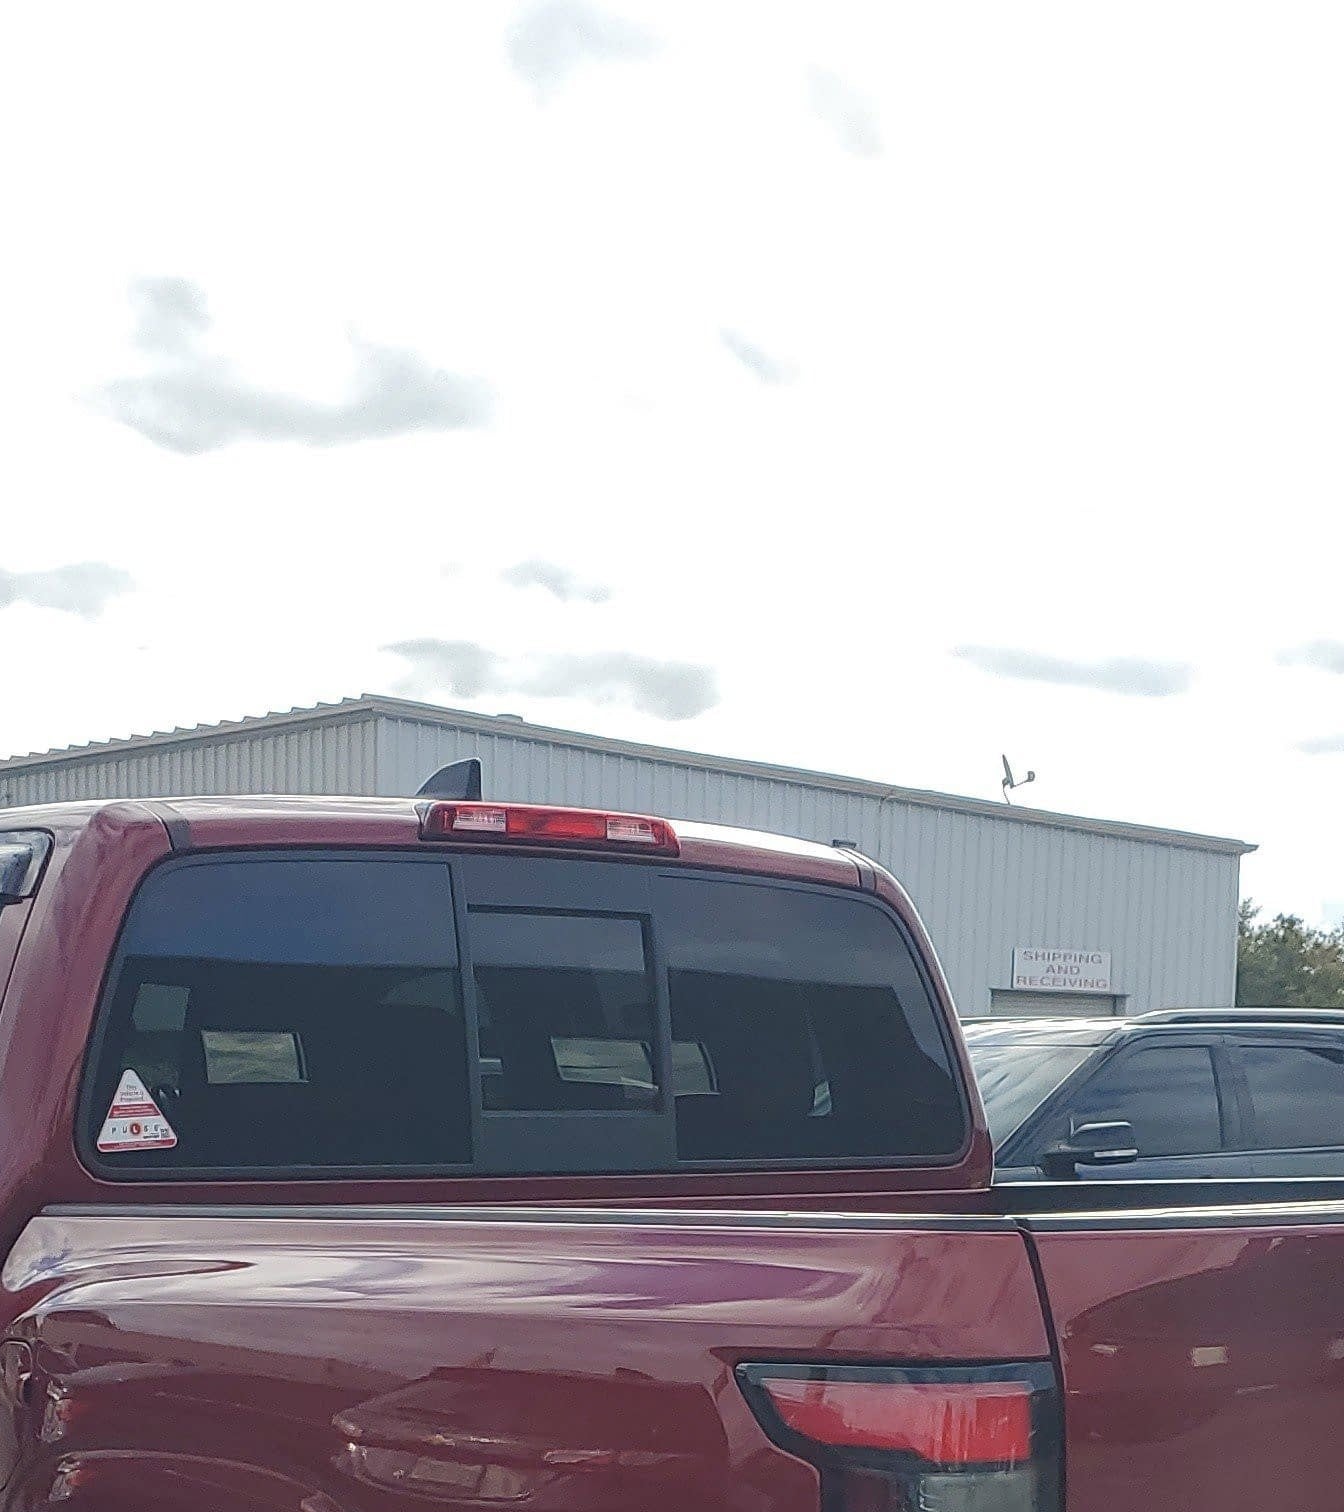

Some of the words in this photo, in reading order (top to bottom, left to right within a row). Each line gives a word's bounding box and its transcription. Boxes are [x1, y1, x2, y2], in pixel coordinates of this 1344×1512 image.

[1023, 951, 1102, 965] SHIPPING
[1046, 965, 1080, 975] AND
[1016, 976, 1107, 988] RECEIVING
